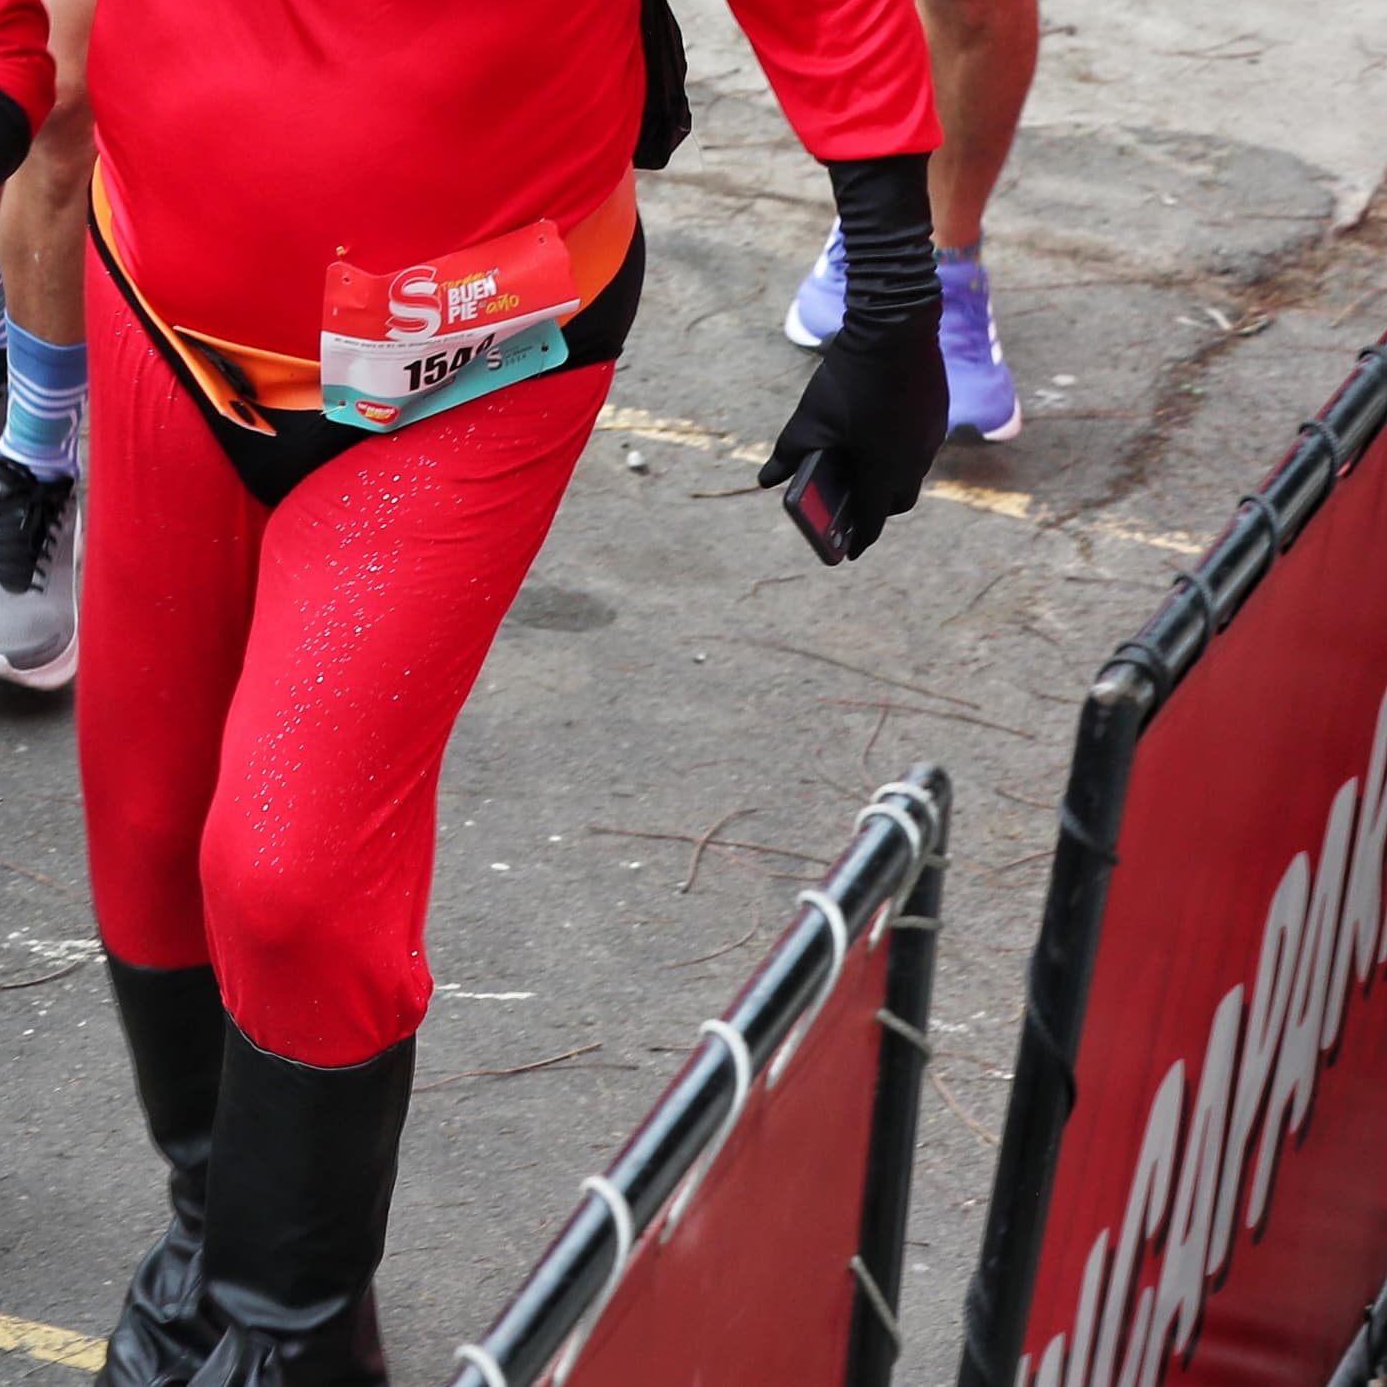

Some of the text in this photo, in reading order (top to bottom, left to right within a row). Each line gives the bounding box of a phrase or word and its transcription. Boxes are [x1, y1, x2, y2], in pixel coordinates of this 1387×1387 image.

[448, 275, 498, 306] BUEN
[448, 294, 520, 325] PIE año
